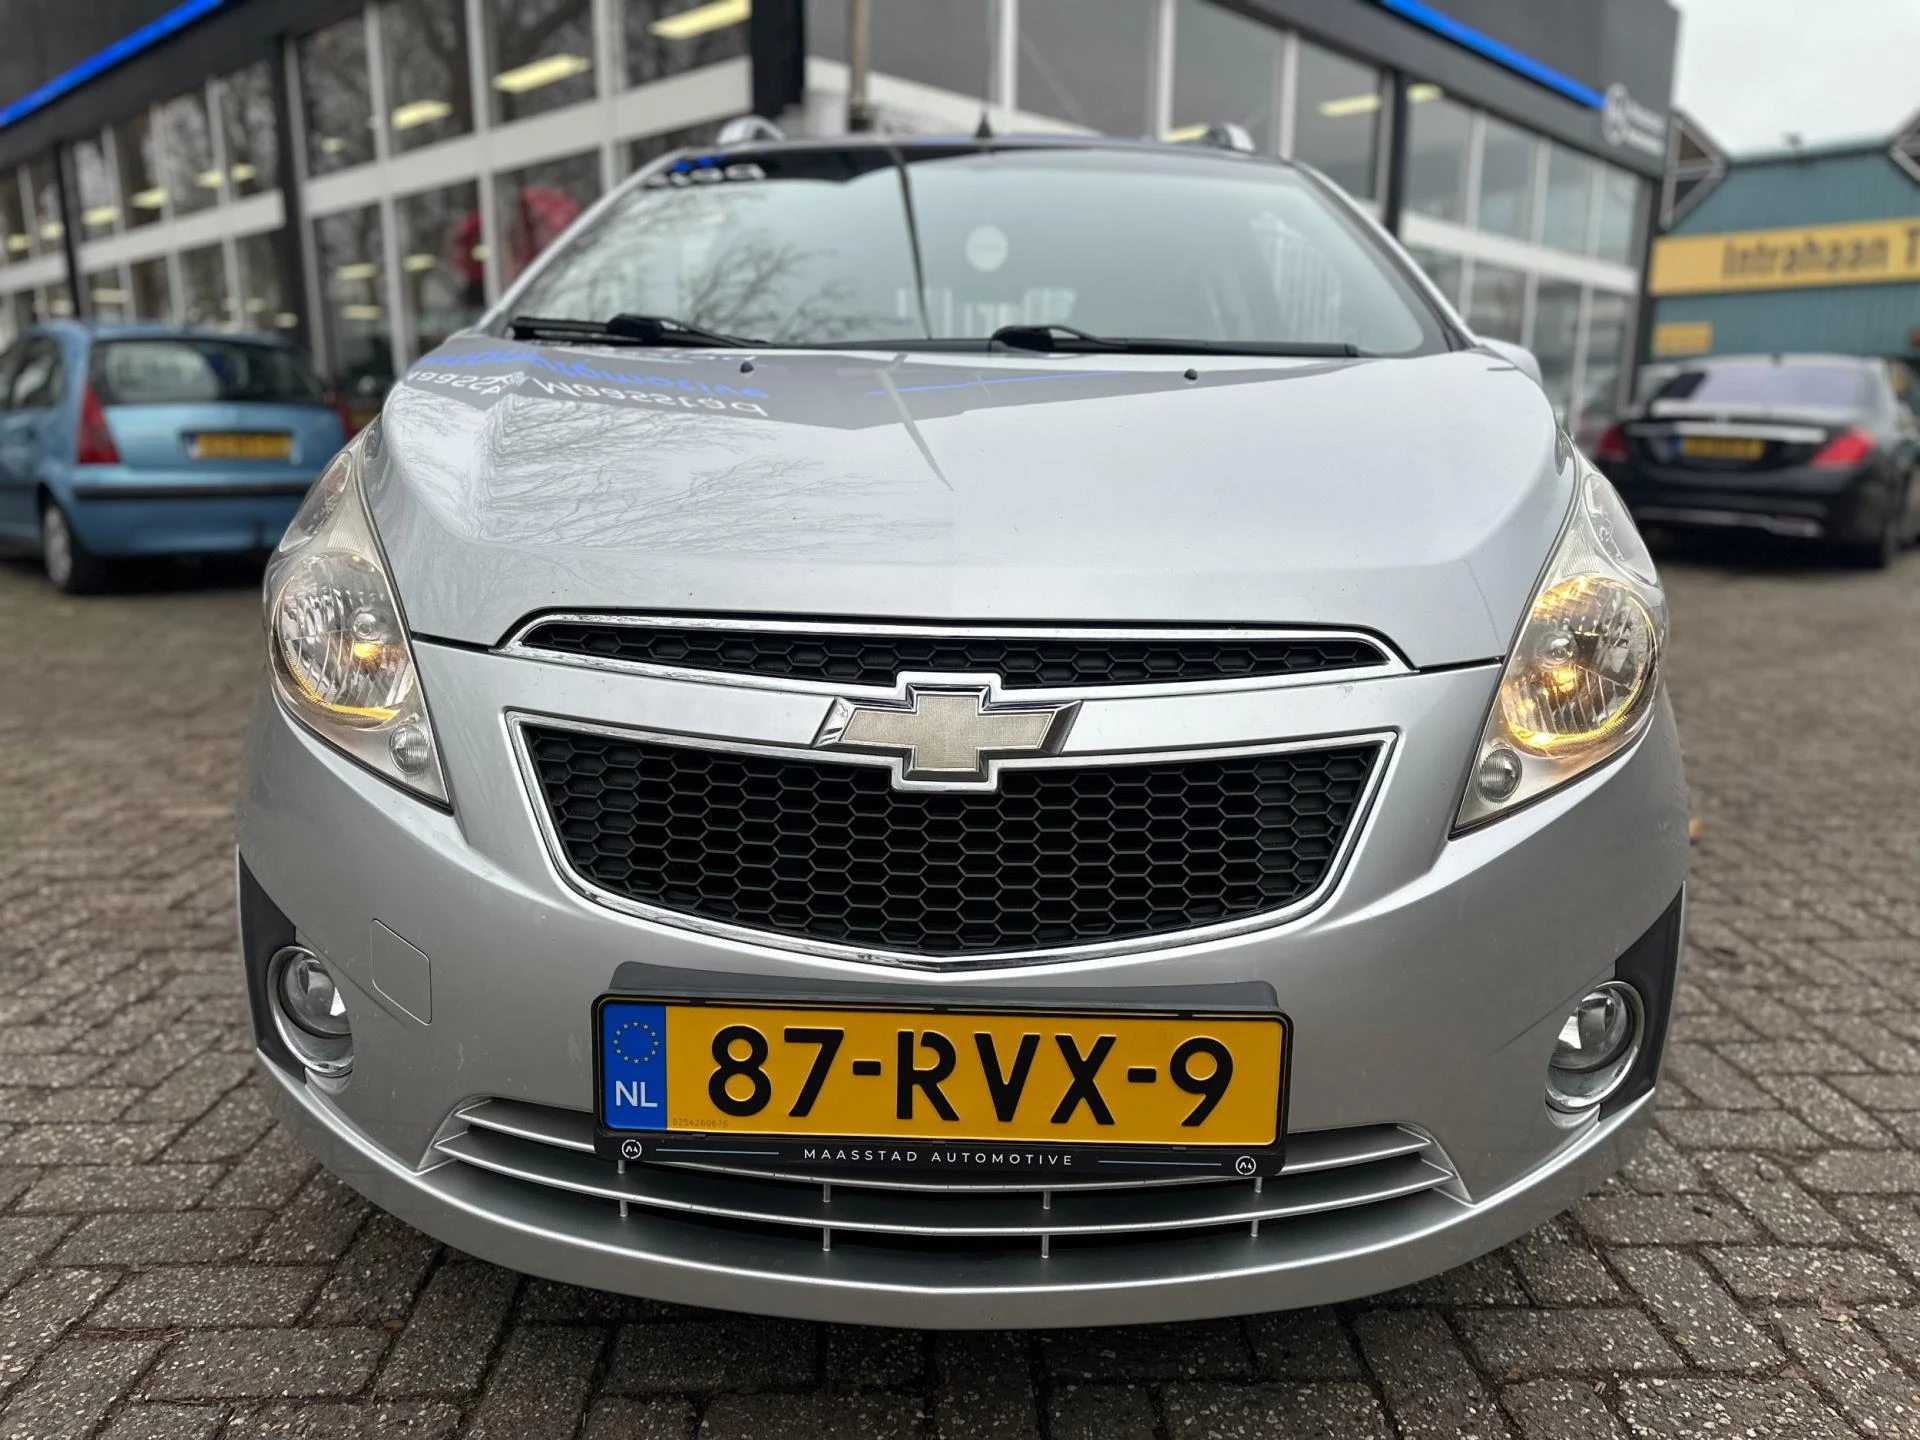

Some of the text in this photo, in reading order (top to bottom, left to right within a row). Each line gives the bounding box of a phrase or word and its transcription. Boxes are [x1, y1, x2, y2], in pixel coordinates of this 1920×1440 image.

[708, 1025, 1233, 1126] 87-RVX-9
[615, 1080, 658, 1107] NL
[804, 1148, 1072, 1166] MAASSTAD AUTOMOTIVE
